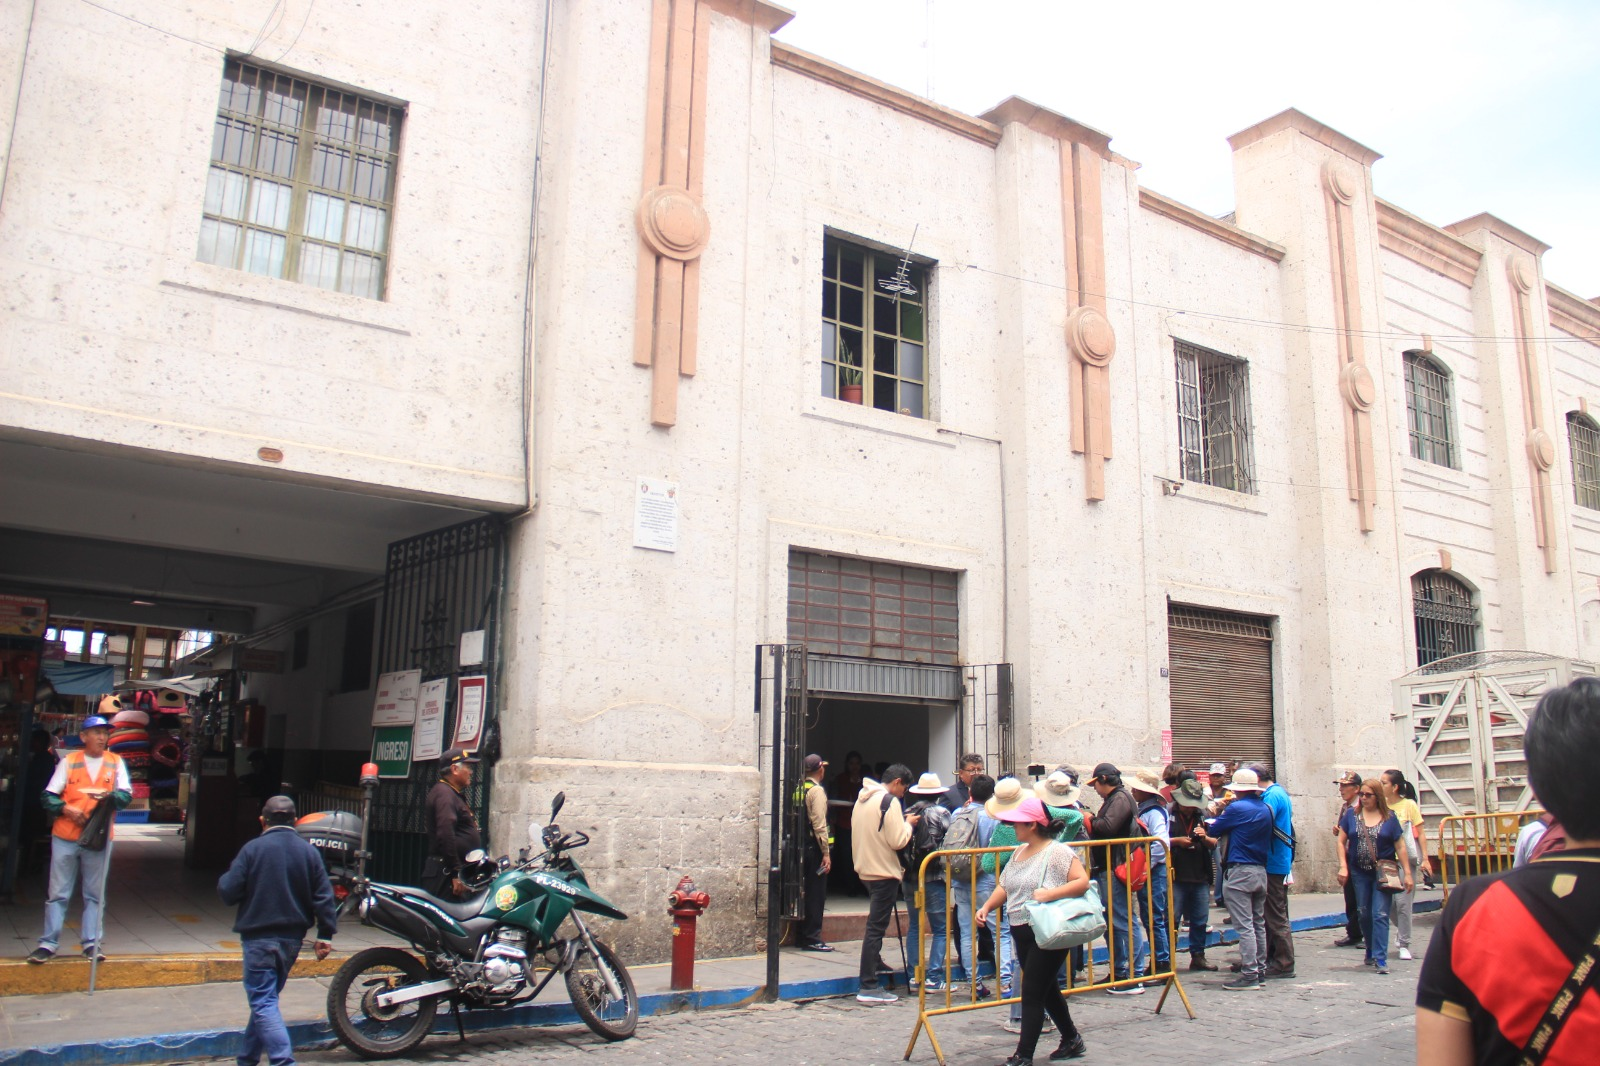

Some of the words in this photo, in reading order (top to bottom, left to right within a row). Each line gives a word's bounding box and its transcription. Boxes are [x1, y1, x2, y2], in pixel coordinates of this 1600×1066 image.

[376, 741, 408, 760] INGRESO
[309, 838, 348, 851] POLICIA
[536, 875, 576, 896] PL-23929
[1572, 954, 1595, 985] PINK
[1551, 989, 1574, 1020] PINK
[1531, 1023, 1553, 1054] PINK
